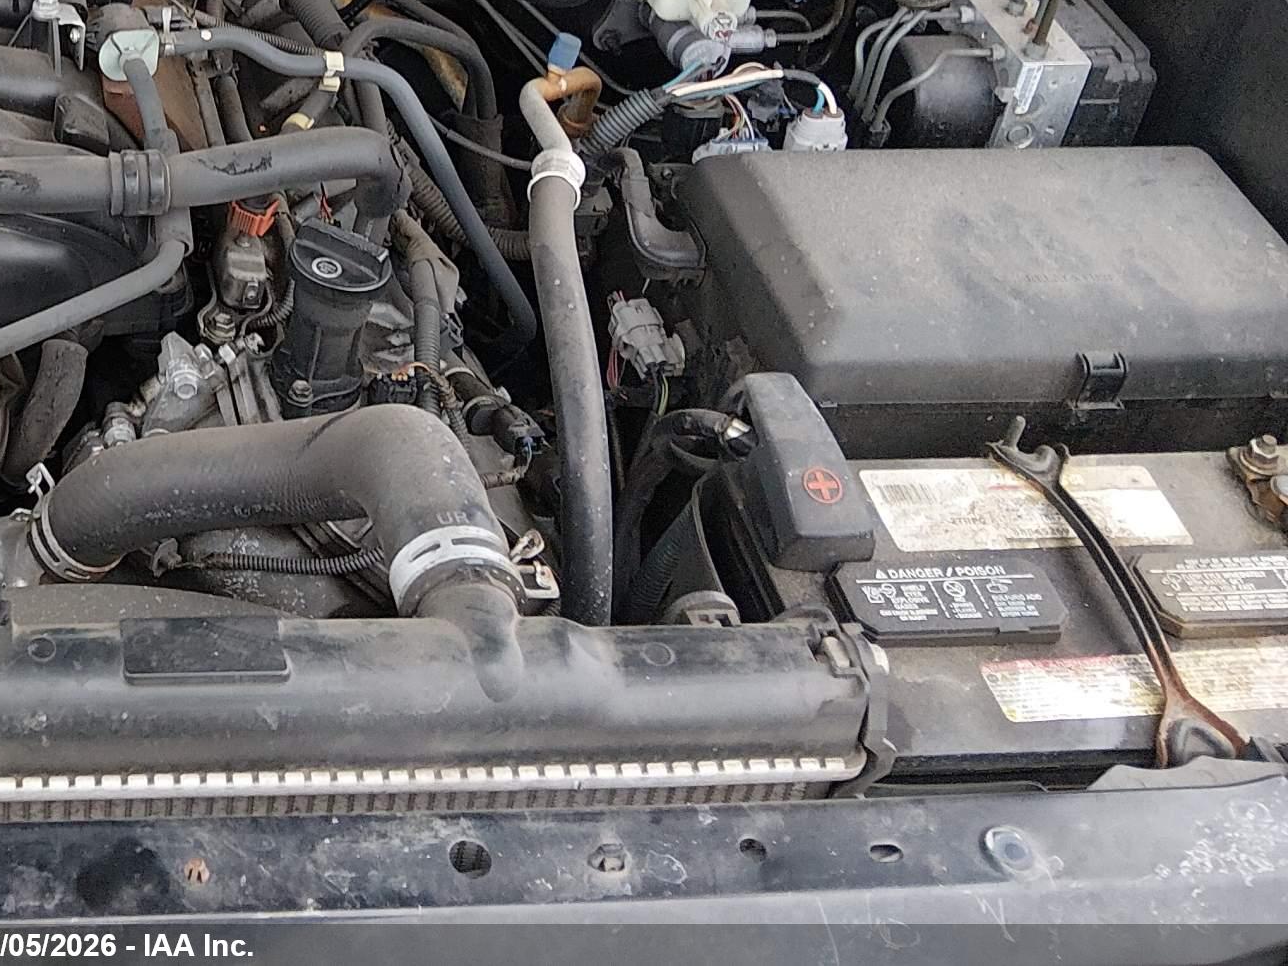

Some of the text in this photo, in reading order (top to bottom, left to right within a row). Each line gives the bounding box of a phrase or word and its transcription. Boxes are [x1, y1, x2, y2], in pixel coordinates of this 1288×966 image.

[436, 511, 470, 525] UR
[887, 567, 944, 579] DANGER
[955, 565, 1006, 576] POISON
